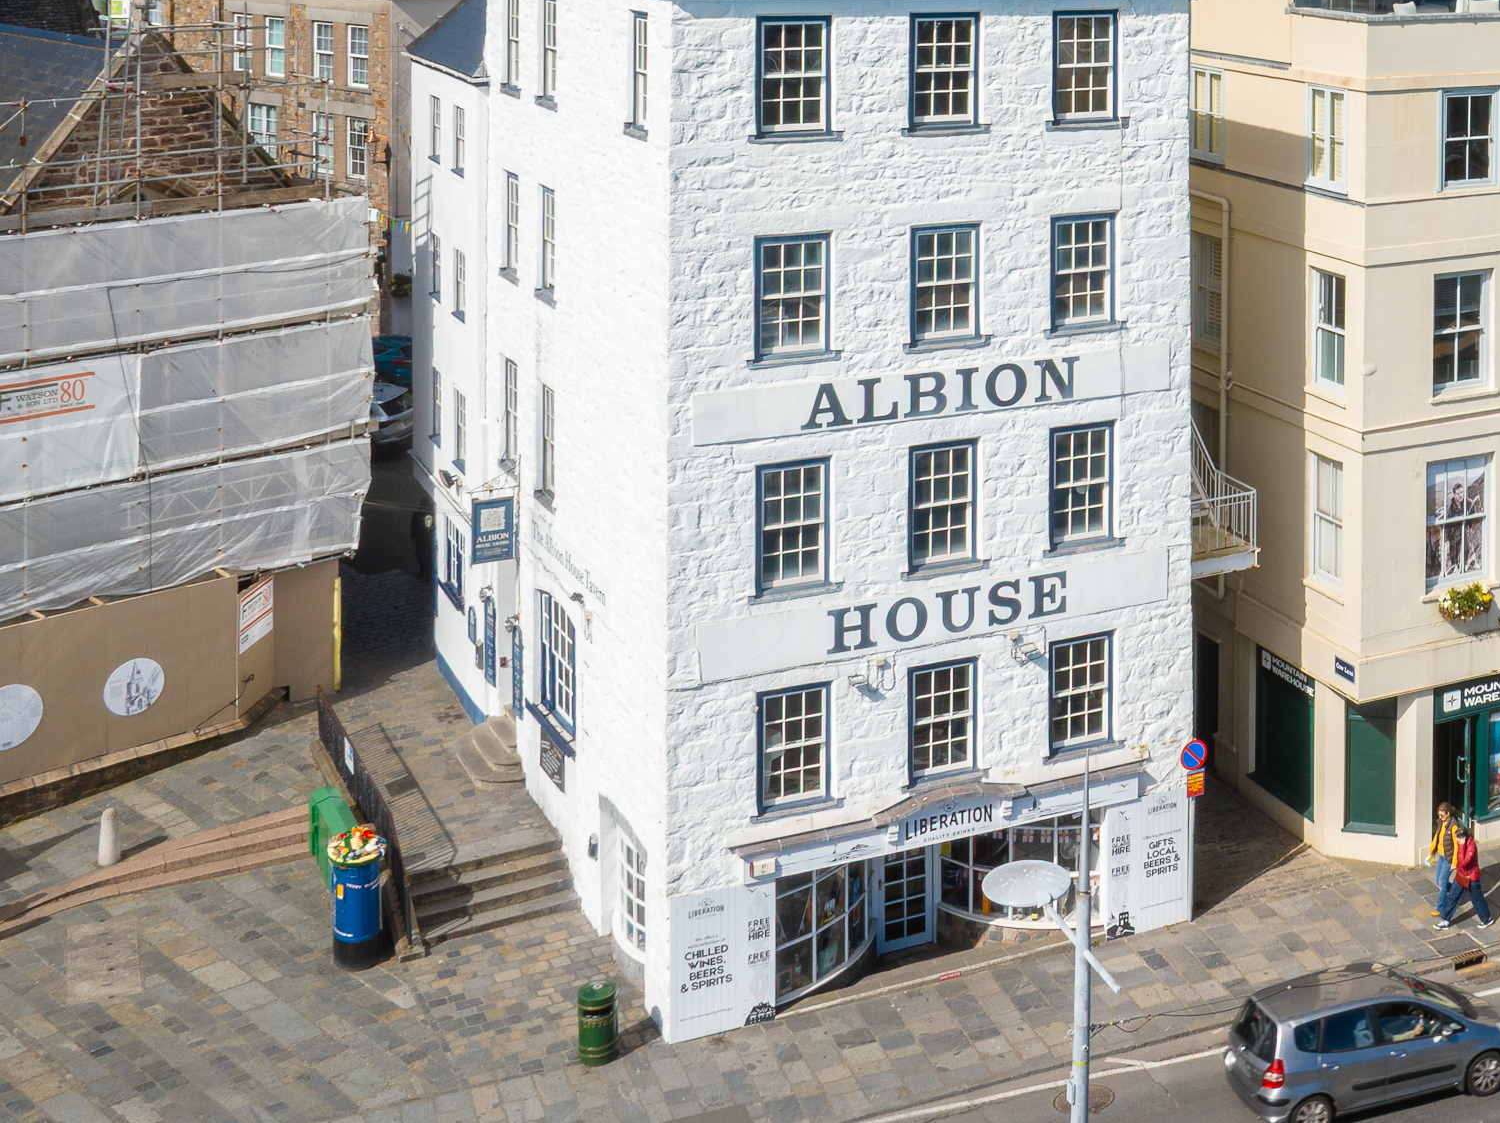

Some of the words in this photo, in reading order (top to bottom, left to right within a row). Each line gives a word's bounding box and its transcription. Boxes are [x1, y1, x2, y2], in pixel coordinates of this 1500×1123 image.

[15, 389, 59, 402] WATSON
[60, 379, 84, 403] 80
[801, 356, 1080, 430] ALBION
[25, 400, 41, 408] SON
[43, 397, 58, 405] LTD
[476, 532, 510, 543] ALBION
[532, 520, 544, 546] The
[544, 533, 564, 566] Albion
[565, 550, 584, 585] House
[585, 569, 606, 607] Tavern
[827, 571, 1067, 654] HOUSE
[1272, 656, 1308, 683] MOUNTAIN
[1272, 665, 1315, 697] WAREHOUSE
[1148, 801, 1177, 815] LIBERATION
[905, 804, 993, 841] LIBERATION
[923, 833, 950, 843] QUALITY
[953, 827, 975, 836] DRINKS
[1111, 833, 1131, 844] FREE
[1148, 837, 1176, 849] GIFTS,
[1111, 845, 1131, 857] HIRE
[1147, 846, 1177, 860] LOCAL
[1143, 856, 1171, 870] BEERS
[1173, 853, 1181, 862] &
[1111, 864, 1131, 875] FREE
[1145, 863, 1179, 878] SPIRITS
[688, 904, 725, 919] LIBERATION
[748, 916, 771, 927] FREE
[748, 929, 771, 941] HIRE
[684, 944, 729, 961] CHILLED
[748, 950, 771, 961] FREE
[688, 955, 726, 970] WINES,
[689, 965, 725, 981] BEERS
[680, 983, 689, 994] &
[691, 973, 733, 991] SPIRITS
